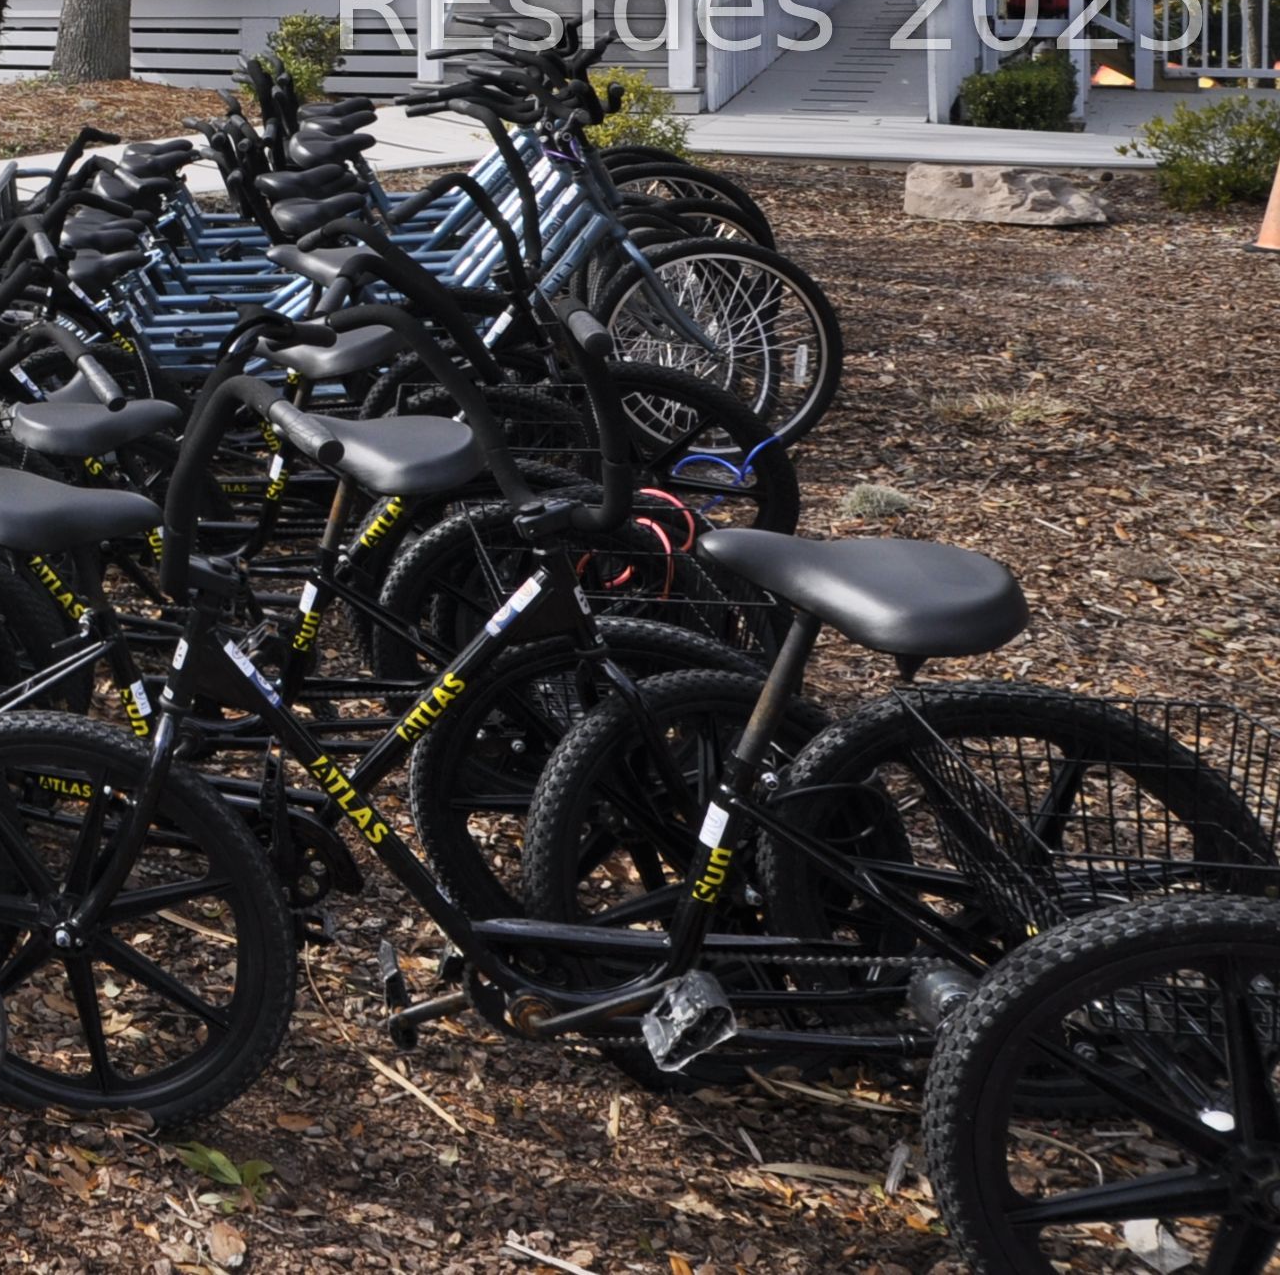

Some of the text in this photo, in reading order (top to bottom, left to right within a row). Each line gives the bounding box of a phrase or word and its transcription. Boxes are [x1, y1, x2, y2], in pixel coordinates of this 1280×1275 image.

[360, 496, 403, 549] ATLA
[28, 555, 85, 620] ATLAS
[395, 671, 465, 742] ATLAS
[39, 776, 92, 798] ATLAS
[309, 755, 389, 844] ATLAS
